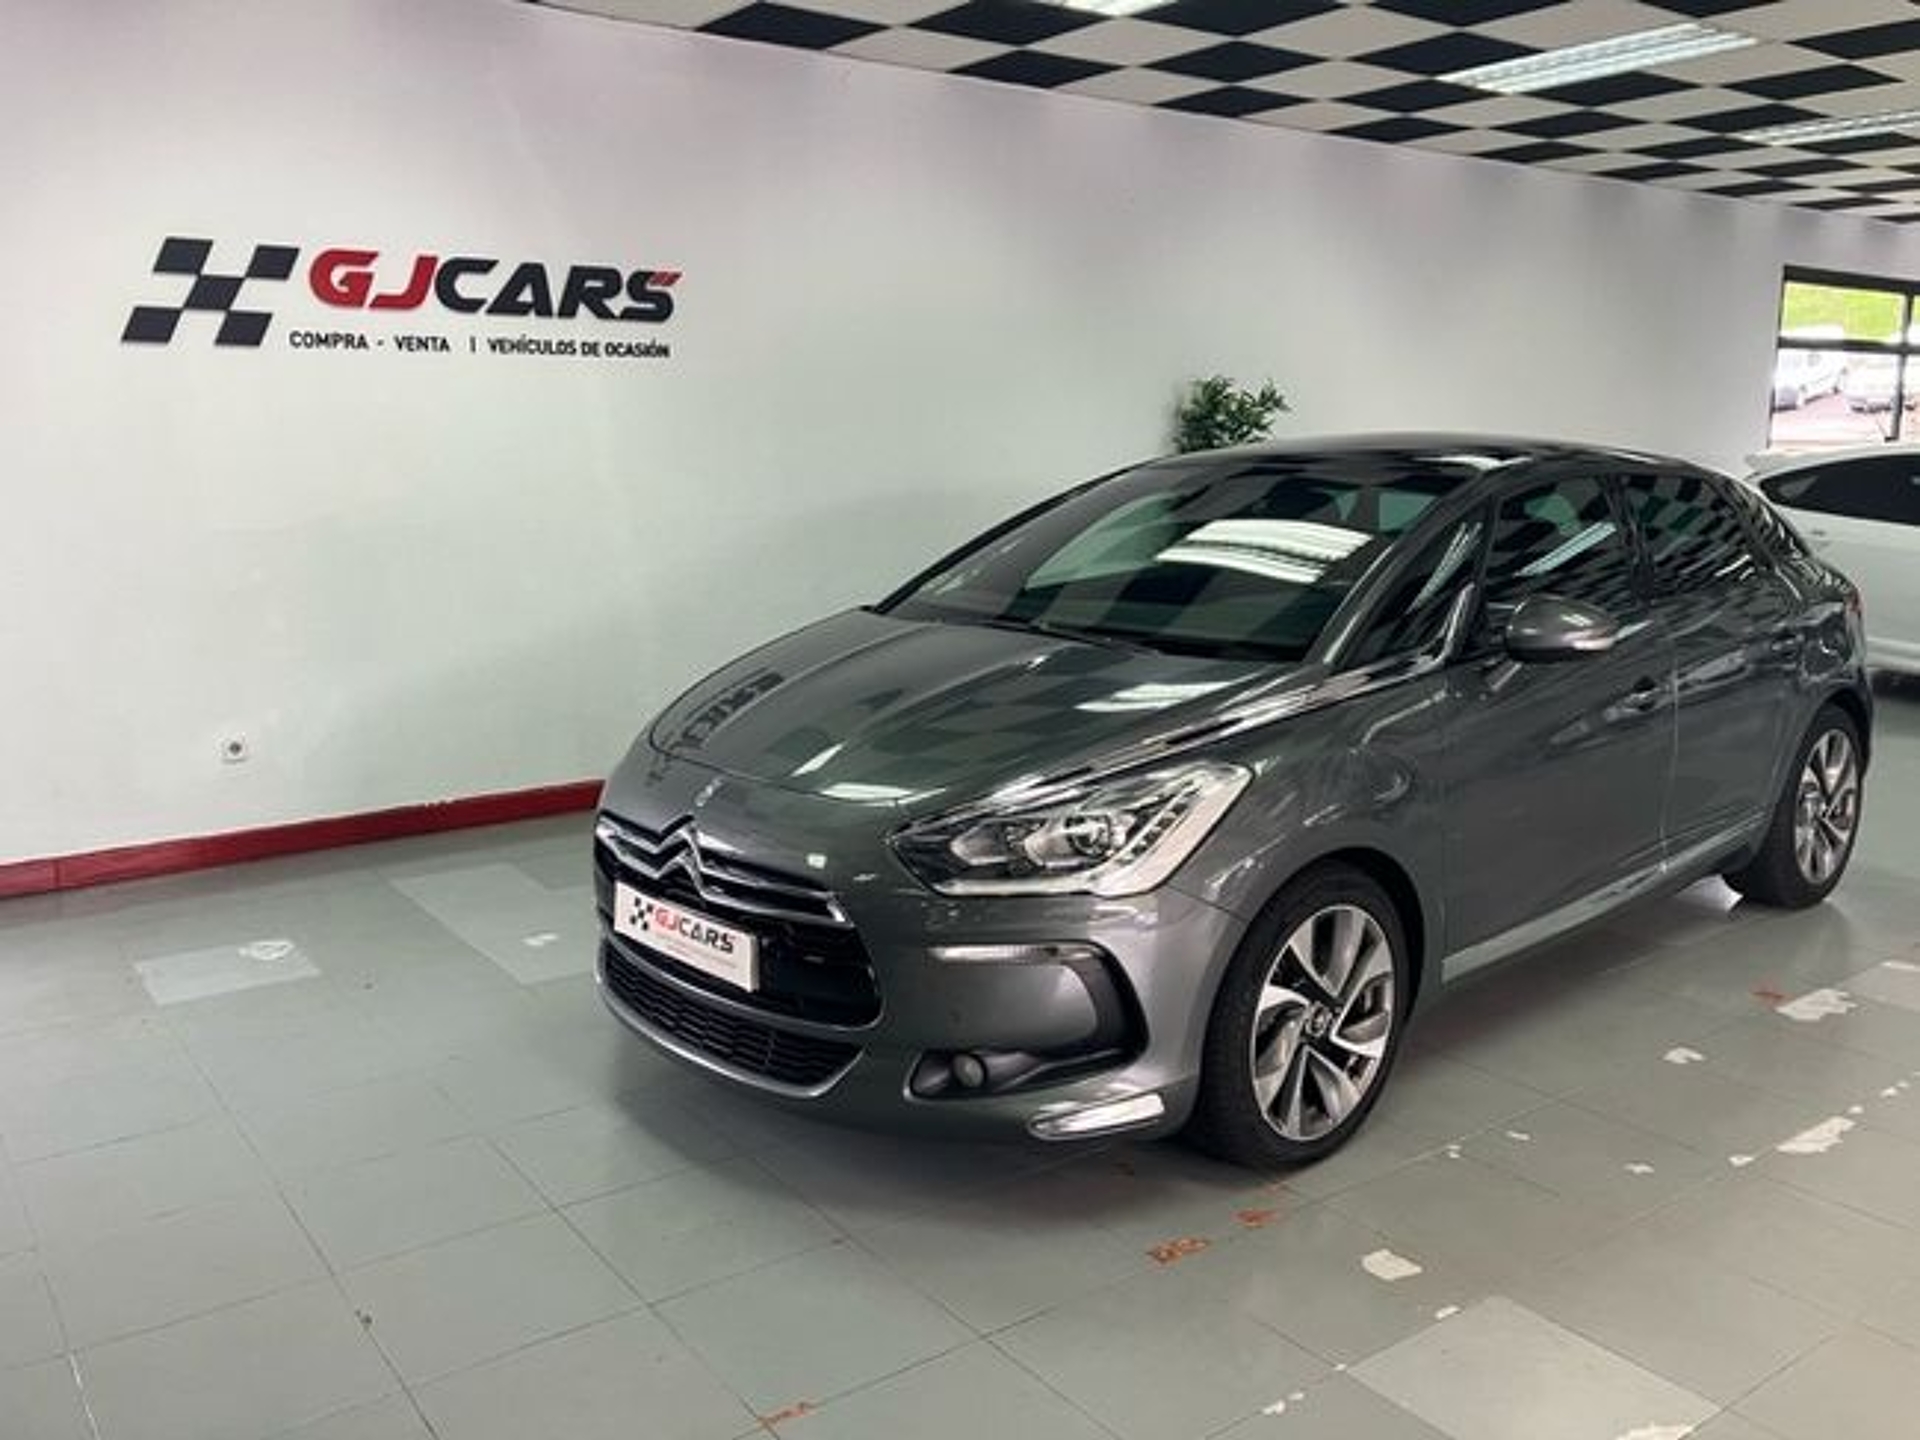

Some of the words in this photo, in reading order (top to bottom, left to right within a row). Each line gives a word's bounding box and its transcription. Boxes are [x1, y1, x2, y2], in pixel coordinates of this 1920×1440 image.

[309, 248, 682, 323] GJCARS
[289, 330, 369, 349] COMPRA
[394, 335, 450, 352] VENTA
[487, 333, 577, 355] VEHÍCULOS
[580, 341, 600, 357] DE
[604, 337, 671, 358] OCASIÓN
